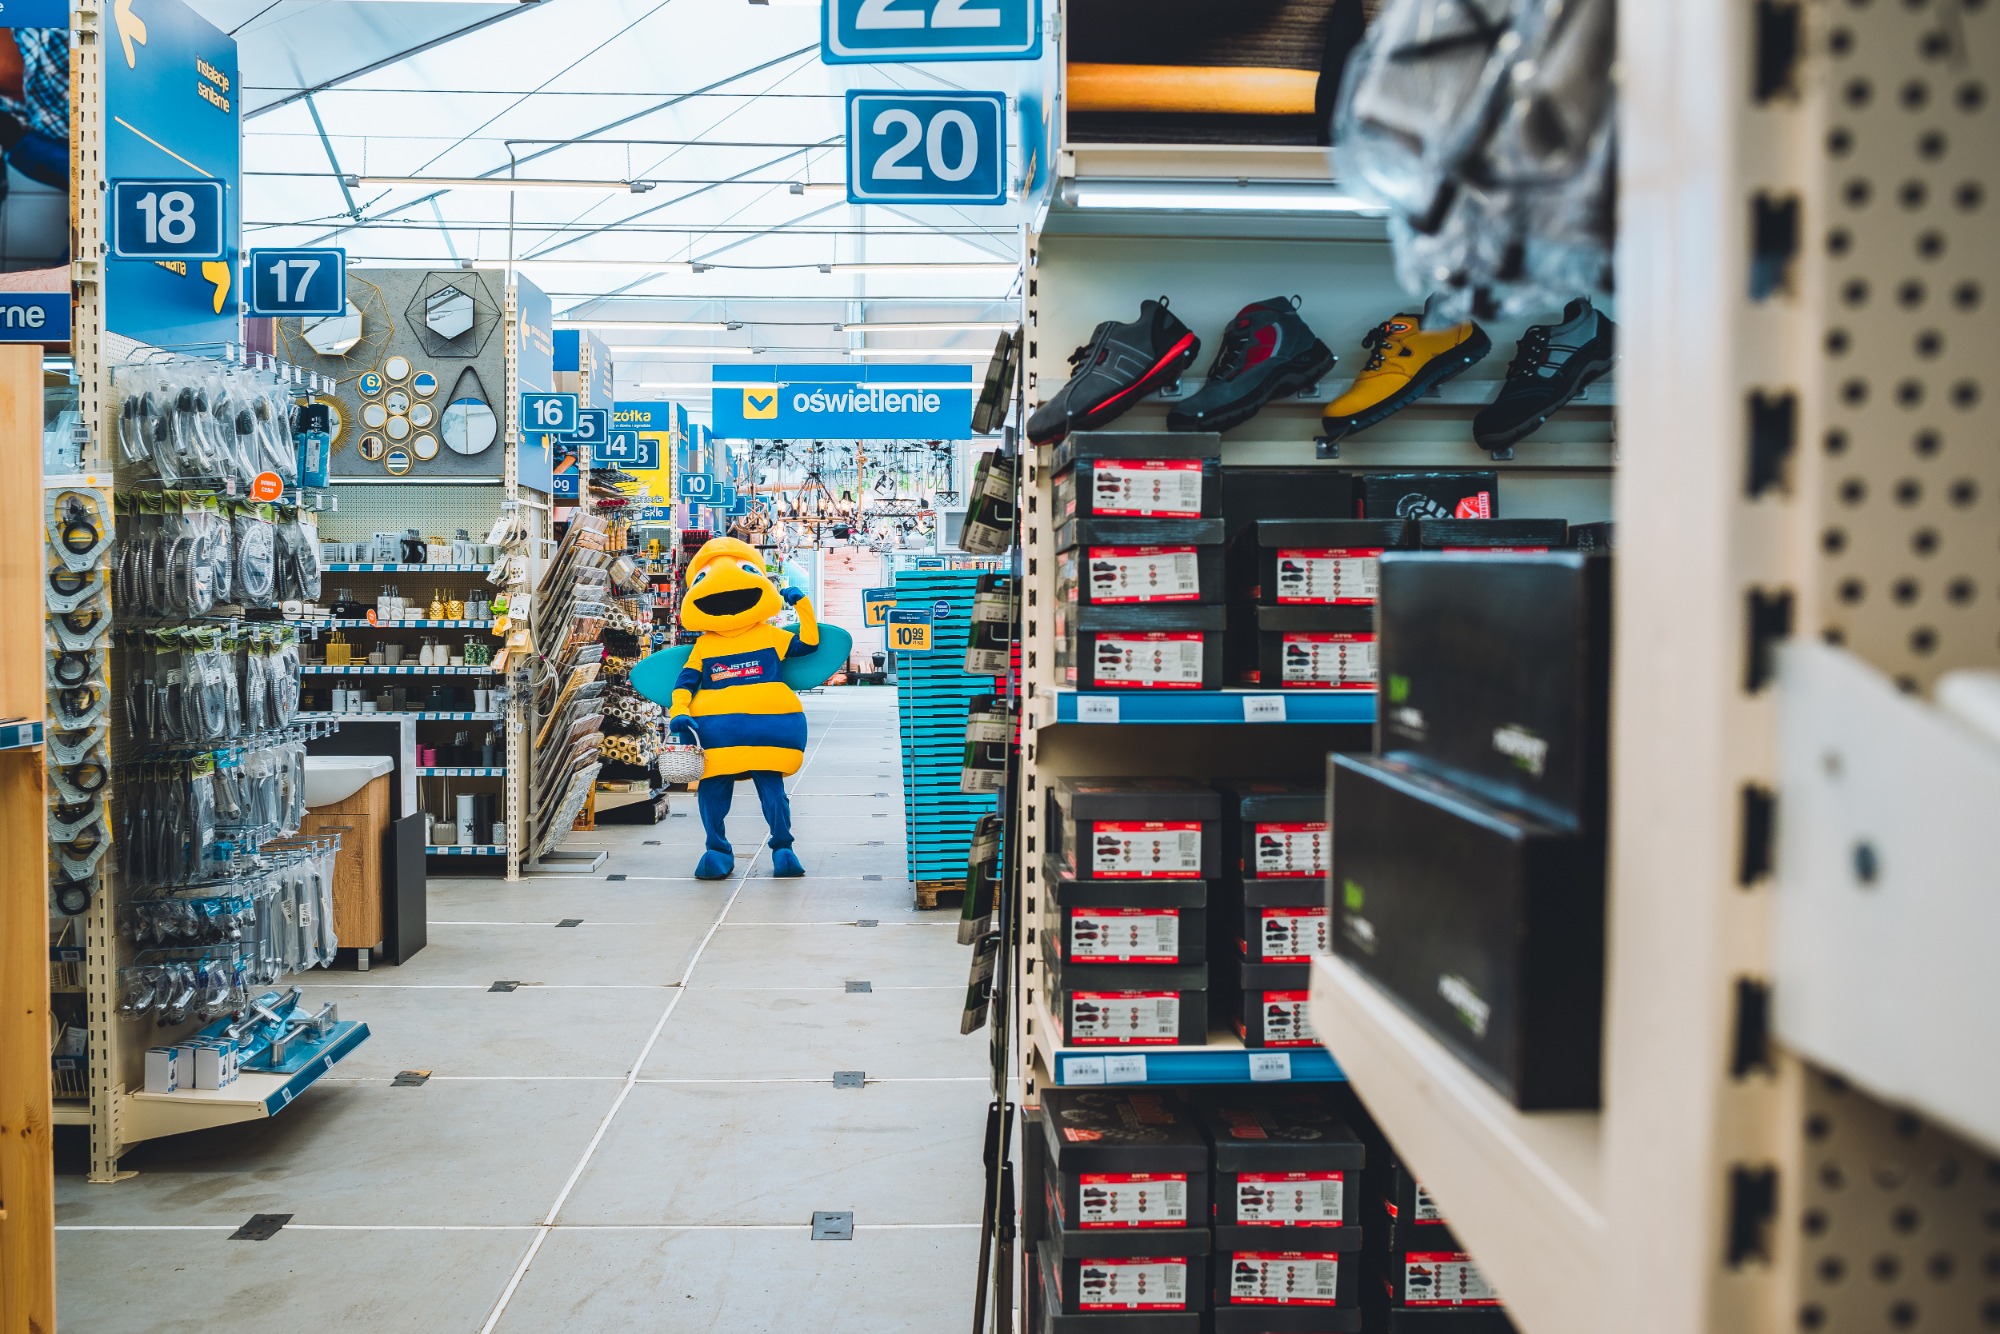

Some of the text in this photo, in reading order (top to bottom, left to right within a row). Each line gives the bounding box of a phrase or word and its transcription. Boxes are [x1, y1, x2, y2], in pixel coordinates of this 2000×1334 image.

[196, 54, 230, 94] instalacje
[197, 81, 230, 114] sanitarne
[872, 109, 979, 182] 20
[136, 191, 196, 244] 18
[269, 259, 321, 303] 17
[533, 398, 563, 426] 16
[793, 388, 941, 413] oświetlenie
[553, 477, 570, 491] óg
[686, 477, 706, 493] 10
[896, 627, 924, 646] 10 99
